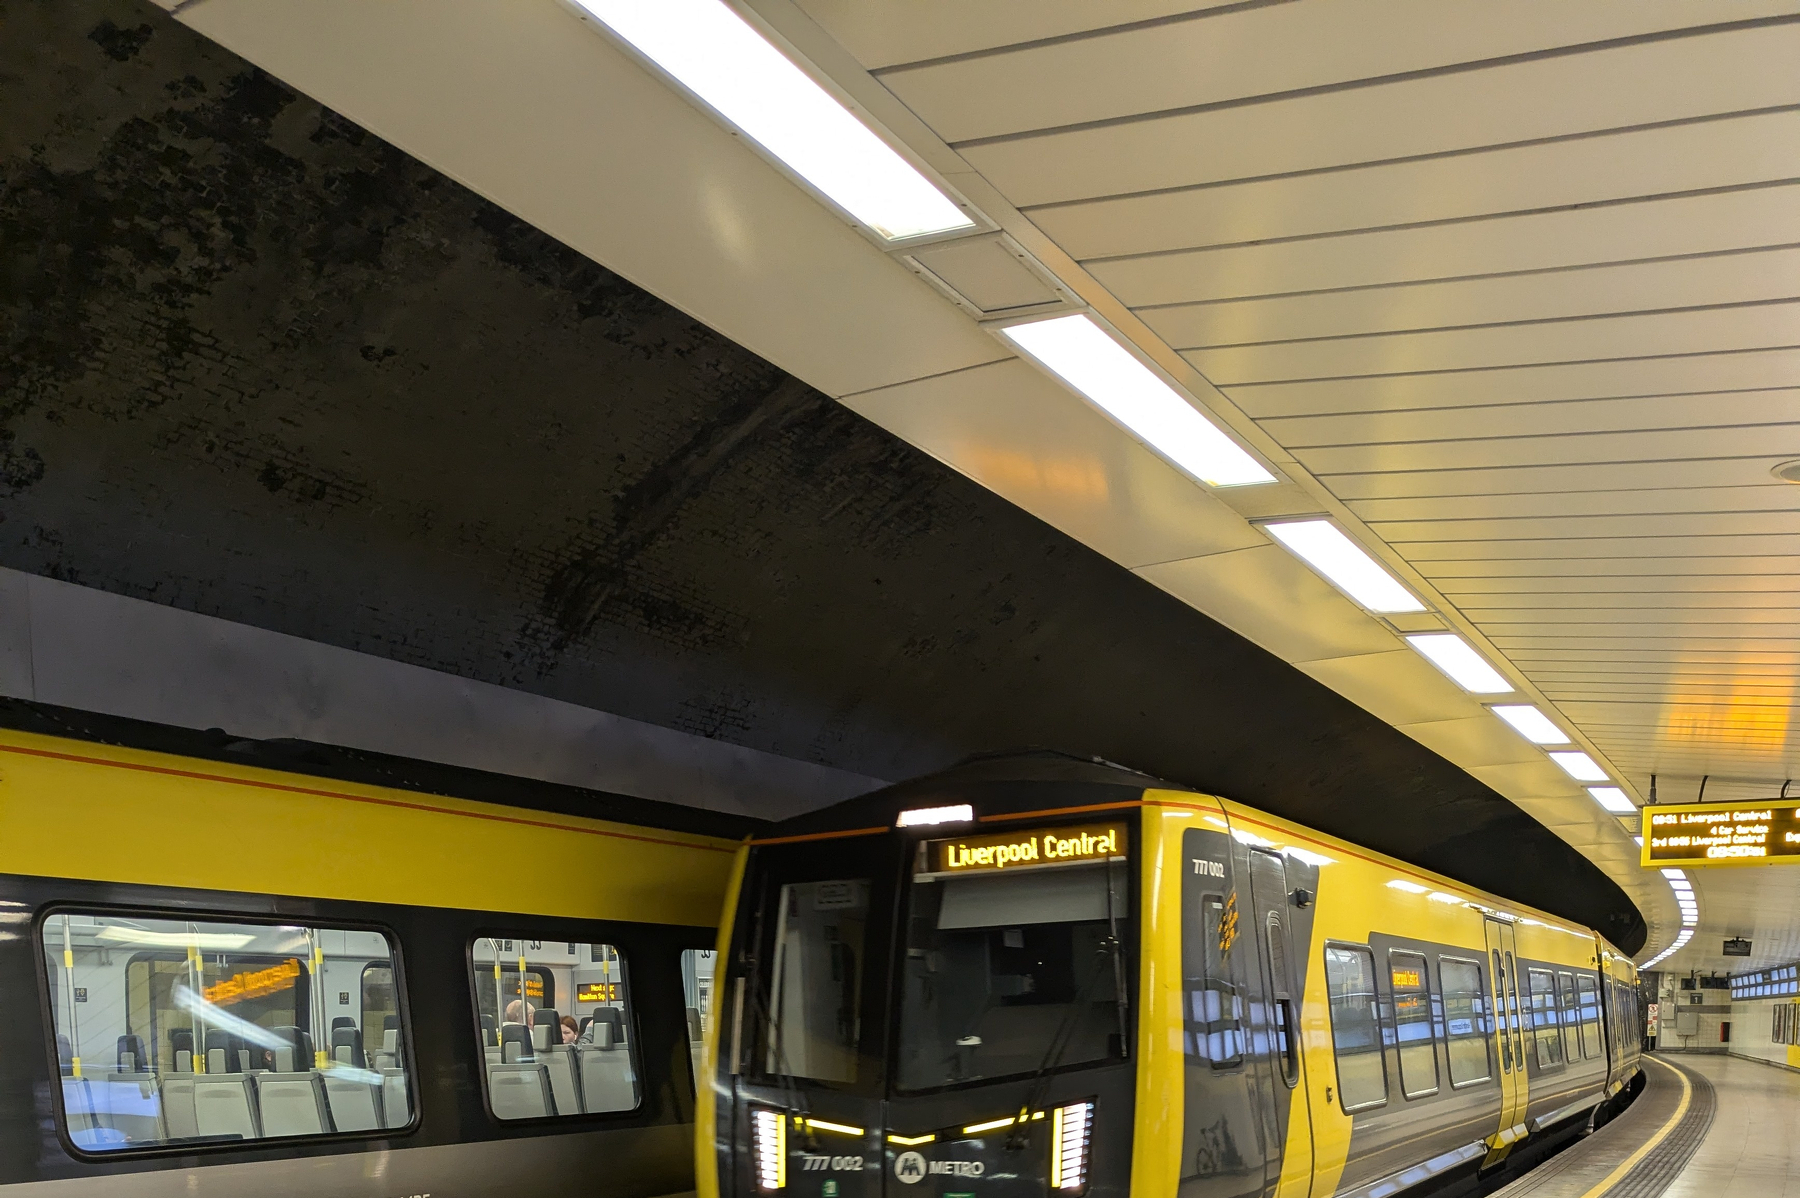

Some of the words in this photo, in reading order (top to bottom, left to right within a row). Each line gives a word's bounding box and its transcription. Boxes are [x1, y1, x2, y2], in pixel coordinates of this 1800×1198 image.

[1681, 812, 1730, 824] Liverpool
[1733, 810, 1772, 821] Central
[948, 837, 1039, 868] Liverpool
[1043, 829, 1117, 859] Central
[1192, 859, 1208, 875] 777
[1208, 861, 1225, 878] 002
[802, 1156, 831, 1171] 777
[831, 1156, 864, 1171] 002
[928, 1161, 985, 1175] METRO
